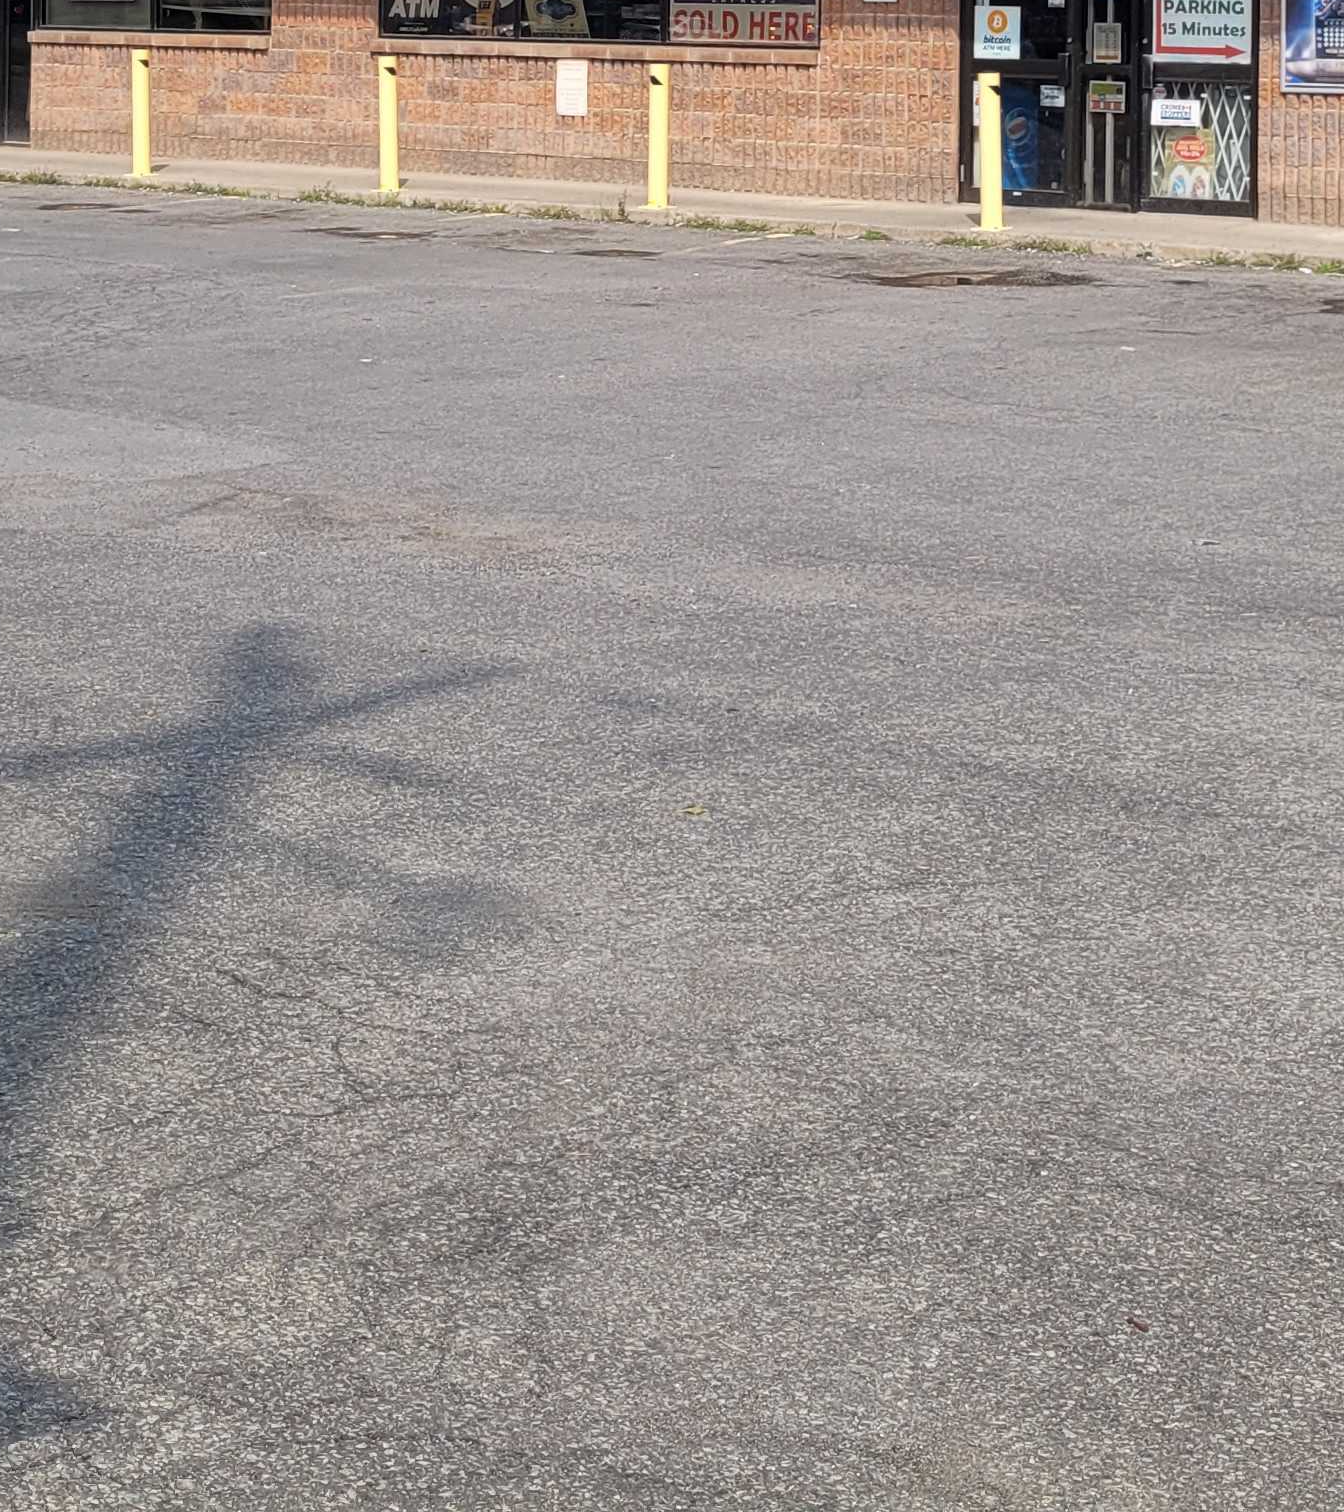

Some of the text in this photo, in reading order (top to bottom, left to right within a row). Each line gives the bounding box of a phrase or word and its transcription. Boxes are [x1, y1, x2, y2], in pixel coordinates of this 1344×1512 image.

[1163, 0, 1245, 14] PARKING
[672, 9, 817, 41] SOLD HERE
[1162, 21, 1246, 37] 15 Minutes
[983, 34, 1012, 44] bitcoin
